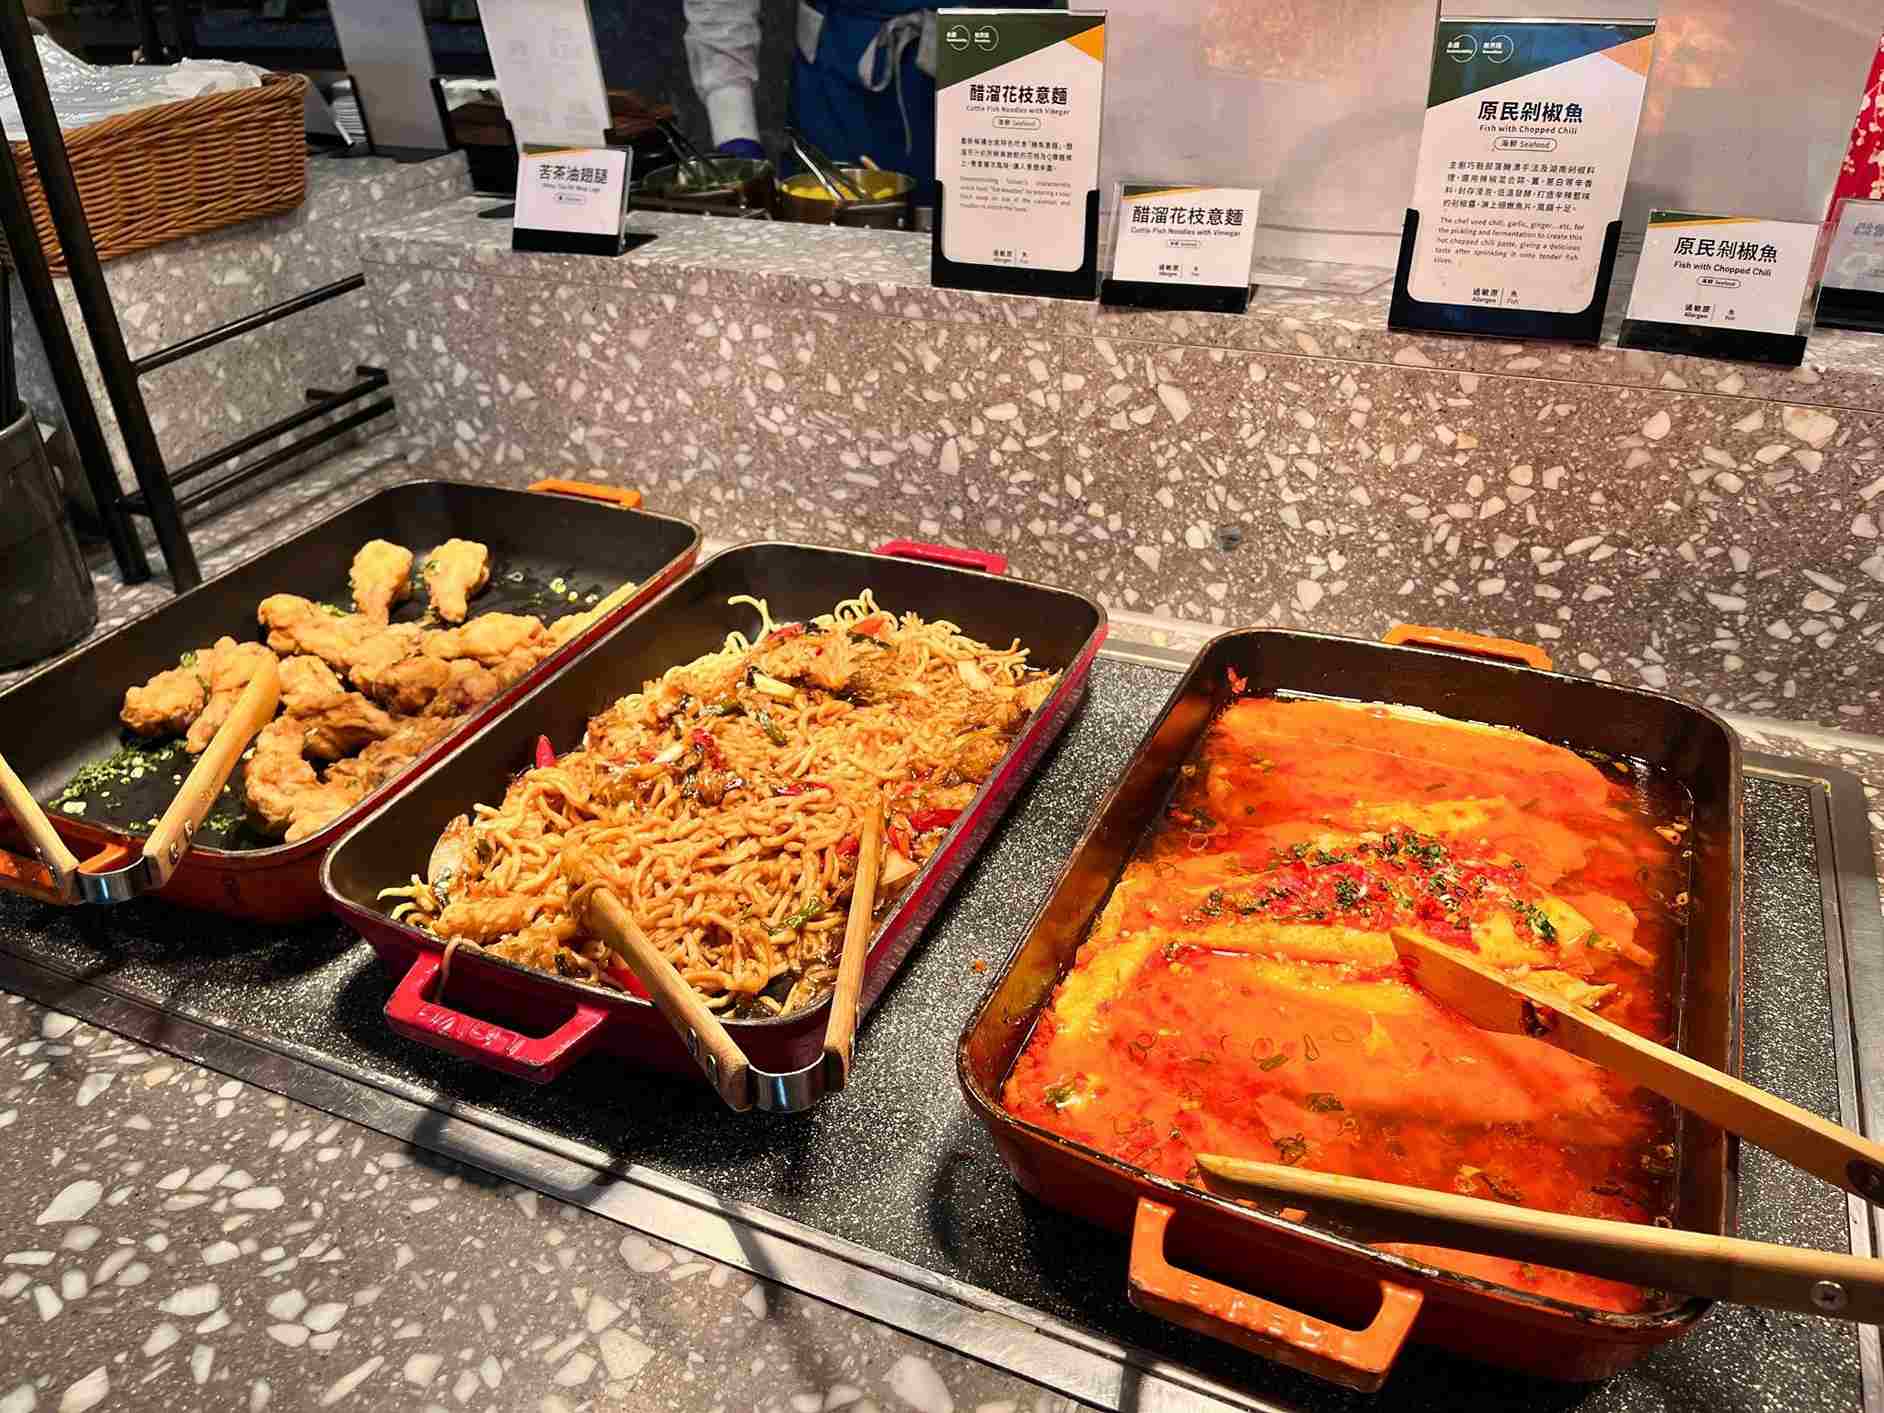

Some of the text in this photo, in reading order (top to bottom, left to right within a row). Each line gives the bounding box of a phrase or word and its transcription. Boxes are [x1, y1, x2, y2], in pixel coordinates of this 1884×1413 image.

[969, 84, 1068, 105] 醋溜花枝意麵
[1478, 101, 1583, 123] 原民剁椒魚
[1519, 126, 1555, 134] Chopped
[1132, 206, 1244, 226] 醋溜花枝意麵
[1674, 237, 1777, 263] 原民剁椒魚
[1674, 260, 1772, 277] Fish with Chopped Chili
